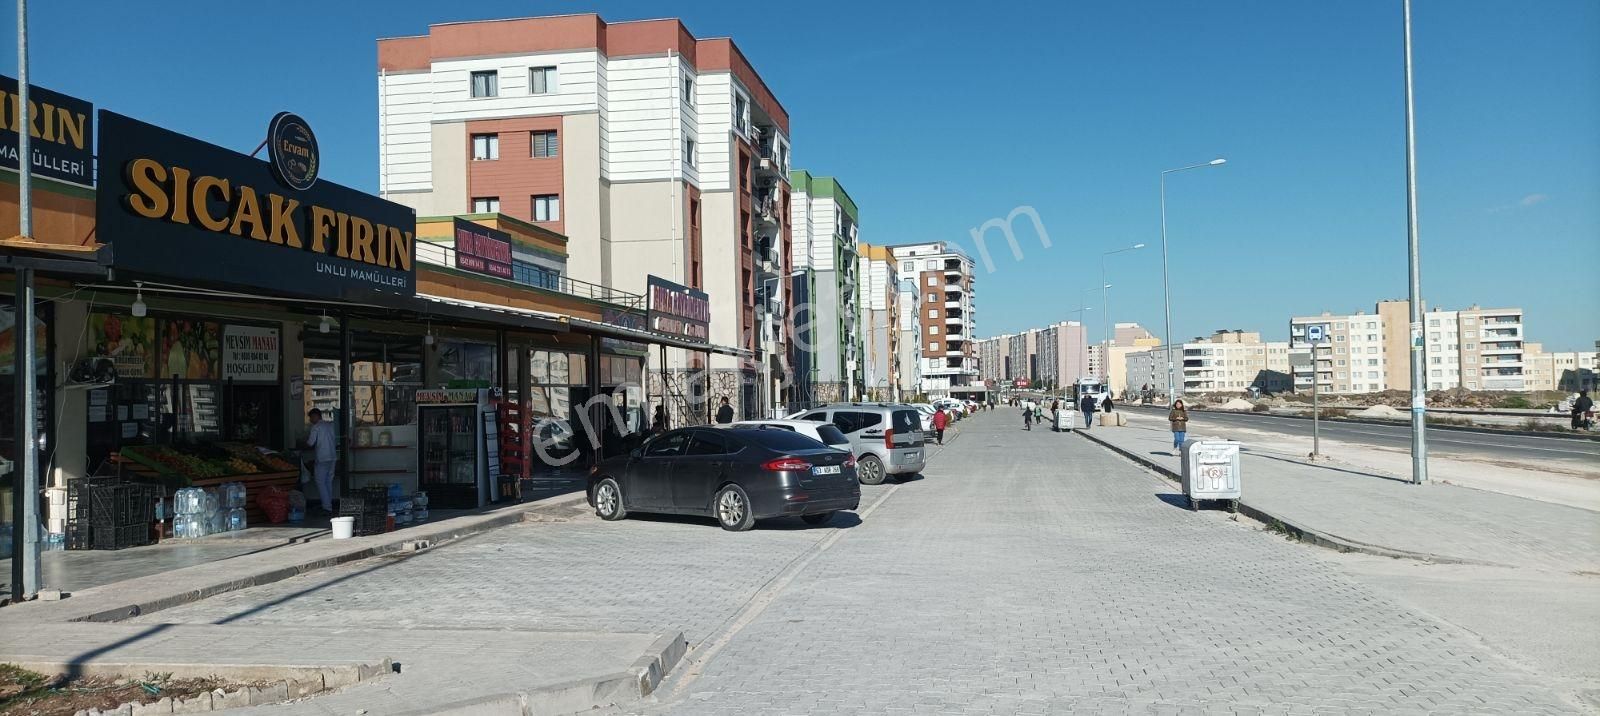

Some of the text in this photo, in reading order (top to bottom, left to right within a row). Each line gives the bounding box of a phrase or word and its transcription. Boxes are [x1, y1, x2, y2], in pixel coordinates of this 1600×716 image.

[0, 145, 84, 177] MAÜLLERİ
[283, 139, 309, 158] Ervam
[127, 158, 413, 272] SICAK FIRIN
[315, 260, 407, 289] UNLU MAMÜLLERİ
[225, 331, 251, 350] MEVSİM
